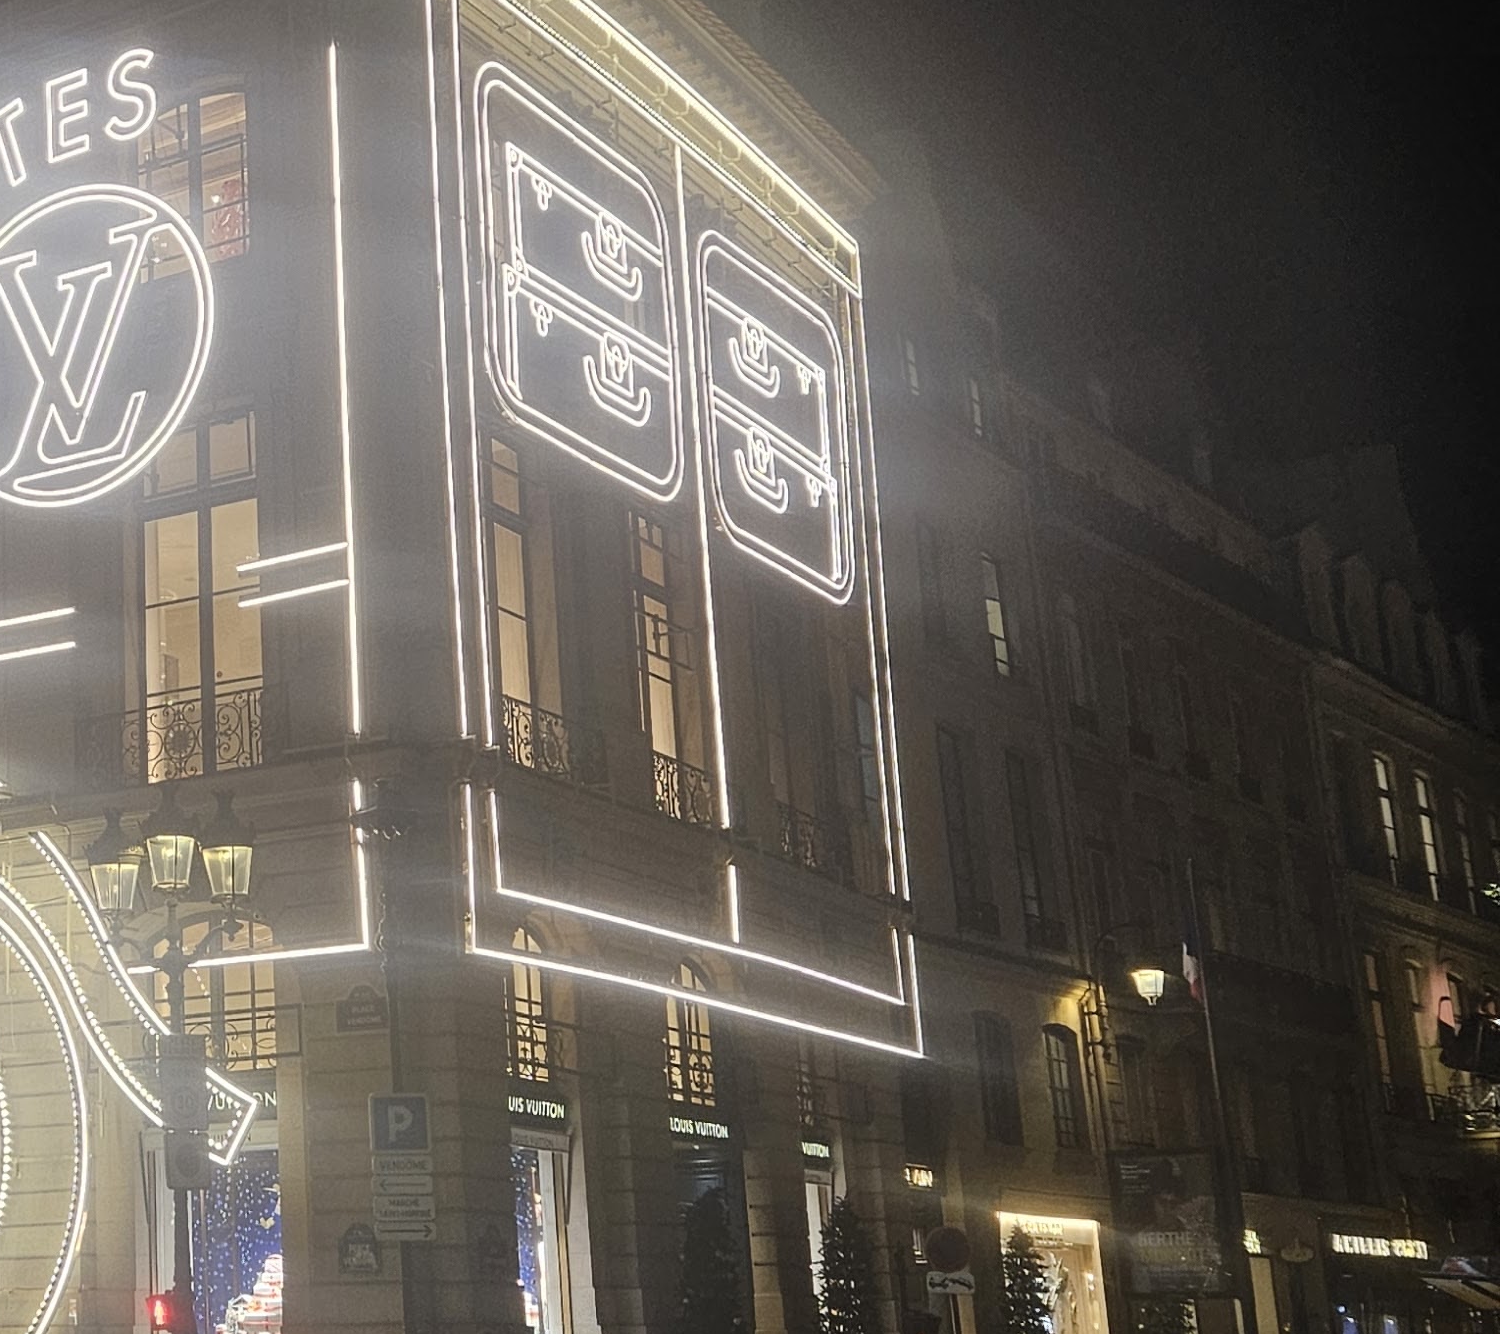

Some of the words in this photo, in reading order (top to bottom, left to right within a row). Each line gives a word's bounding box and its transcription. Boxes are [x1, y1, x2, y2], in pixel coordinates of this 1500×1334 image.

[508, 1095, 524, 1113] UIS
[526, 1098, 565, 1119] VUITTON
[388, 1104, 413, 1142] P
[669, 1117, 694, 1134] LOUIS
[694, 1120, 729, 1139] VUITTON
